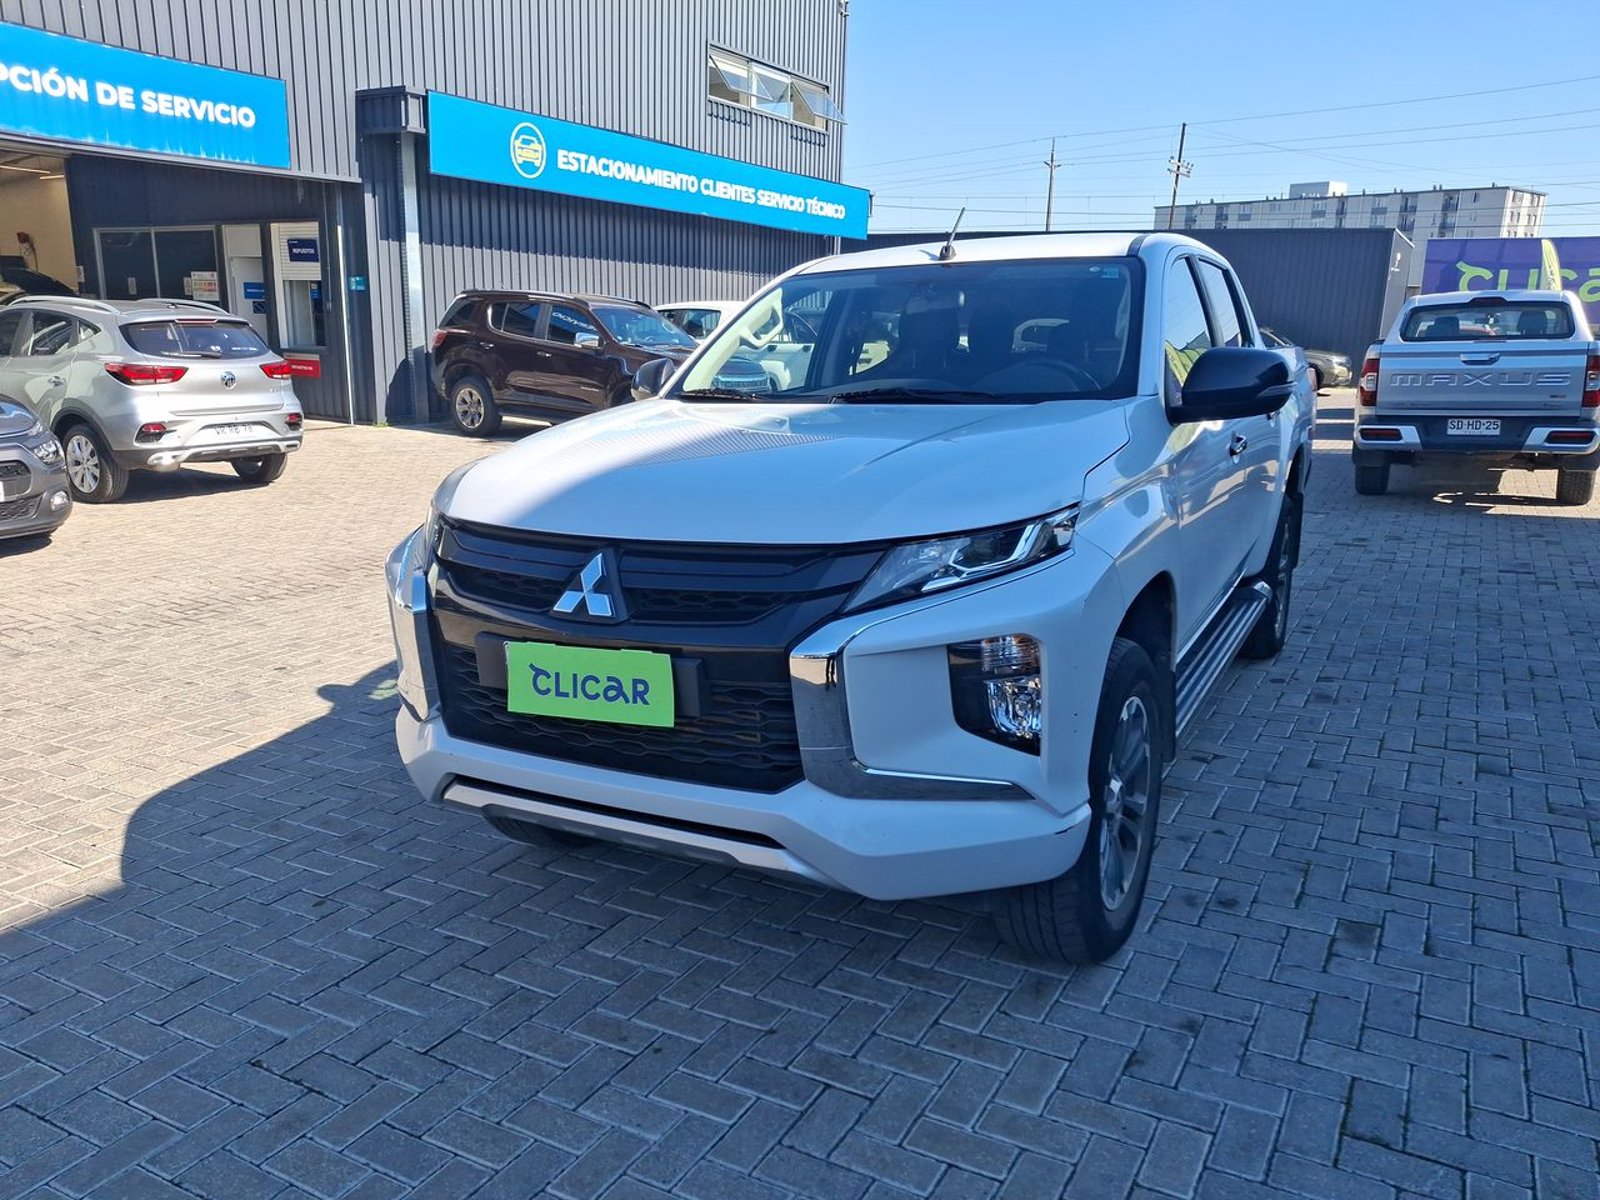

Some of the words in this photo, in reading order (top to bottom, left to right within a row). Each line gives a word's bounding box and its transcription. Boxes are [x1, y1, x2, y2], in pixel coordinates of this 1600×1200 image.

[95, 81, 136, 110] DE
[141, 90, 256, 128] SERVICIO
[557, 149, 699, 194] ESTACIONAMIENTO
[700, 178, 756, 204] CLIENTES
[757, 189, 805, 212] SERVICIO
[806, 196, 846, 219] TÉCNICO
[1390, 372, 1571, 387] MAXUS
